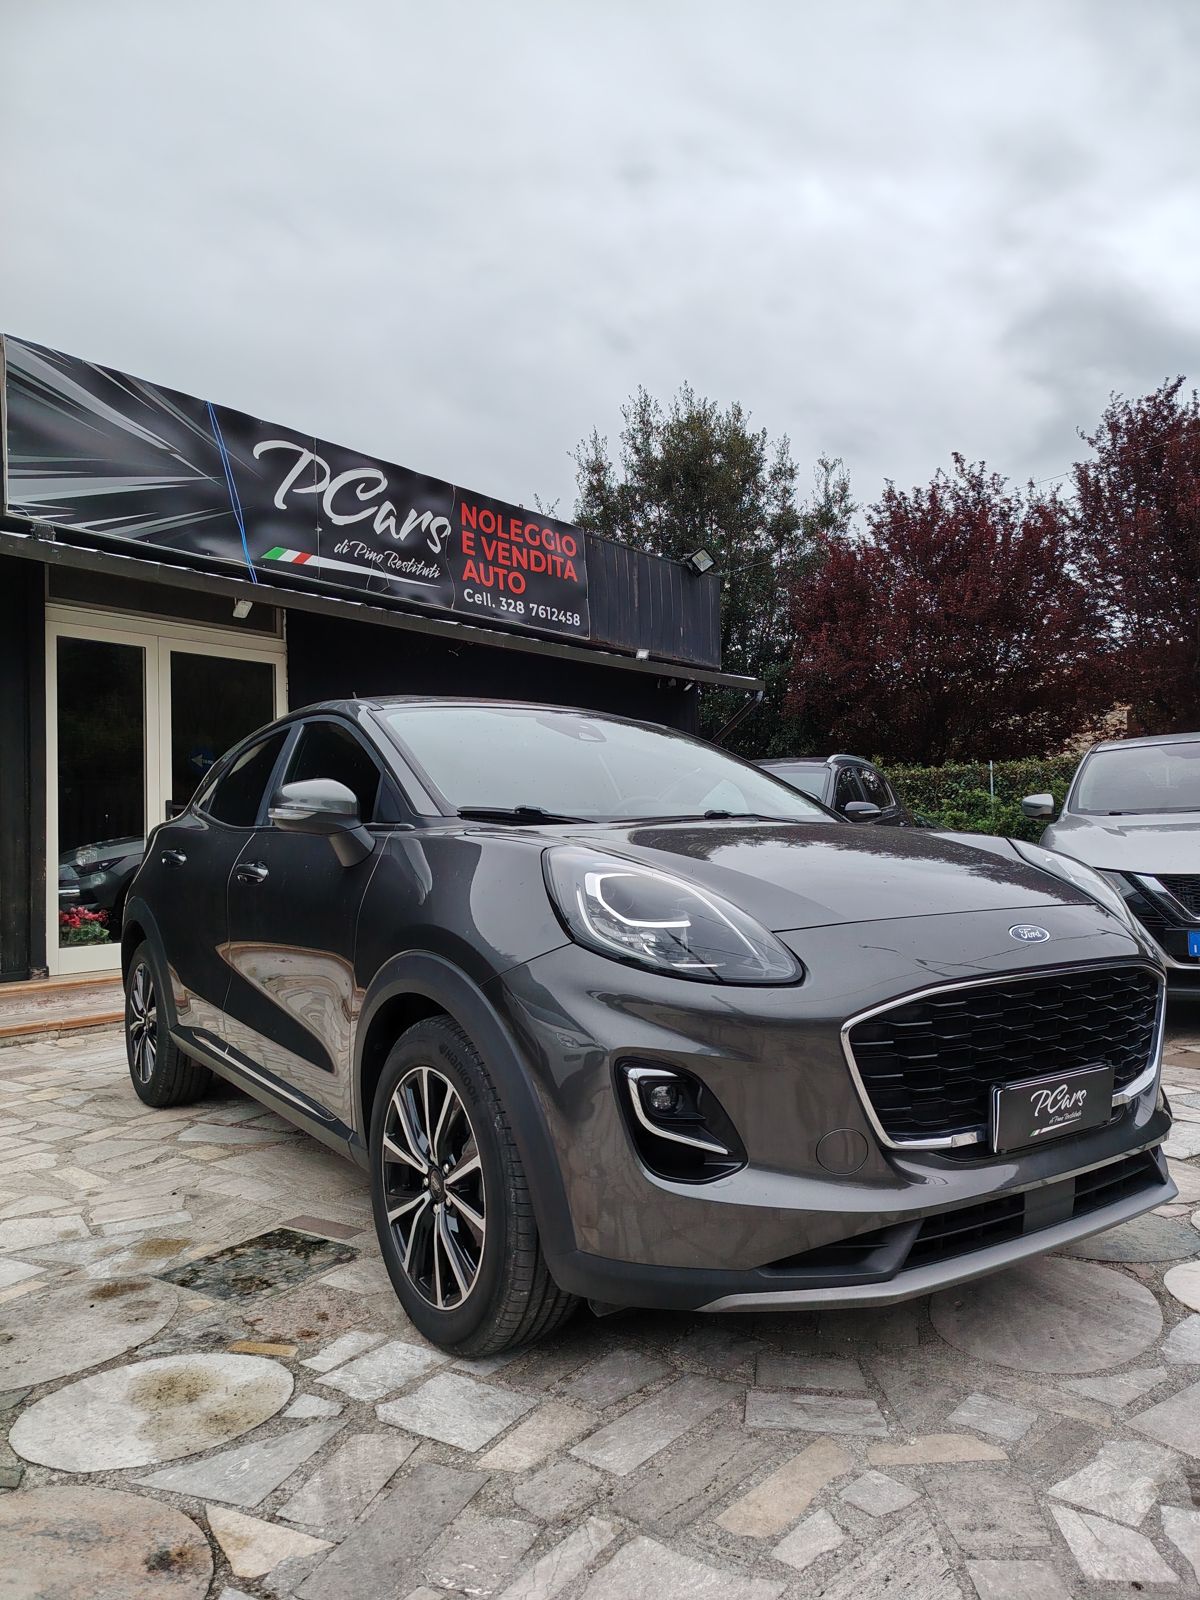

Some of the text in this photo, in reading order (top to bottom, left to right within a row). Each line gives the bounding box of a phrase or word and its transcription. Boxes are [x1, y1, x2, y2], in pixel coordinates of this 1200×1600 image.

[461, 502, 577, 557] NOLEGGIO
[334, 539, 441, 578] di Pino Restituti
[462, 530, 578, 582] E VENDITA
[462, 559, 526, 594] AUTO
[463, 588, 581, 626] Cell. 328 7612458
[1018, 928, 1043, 939] Ford
